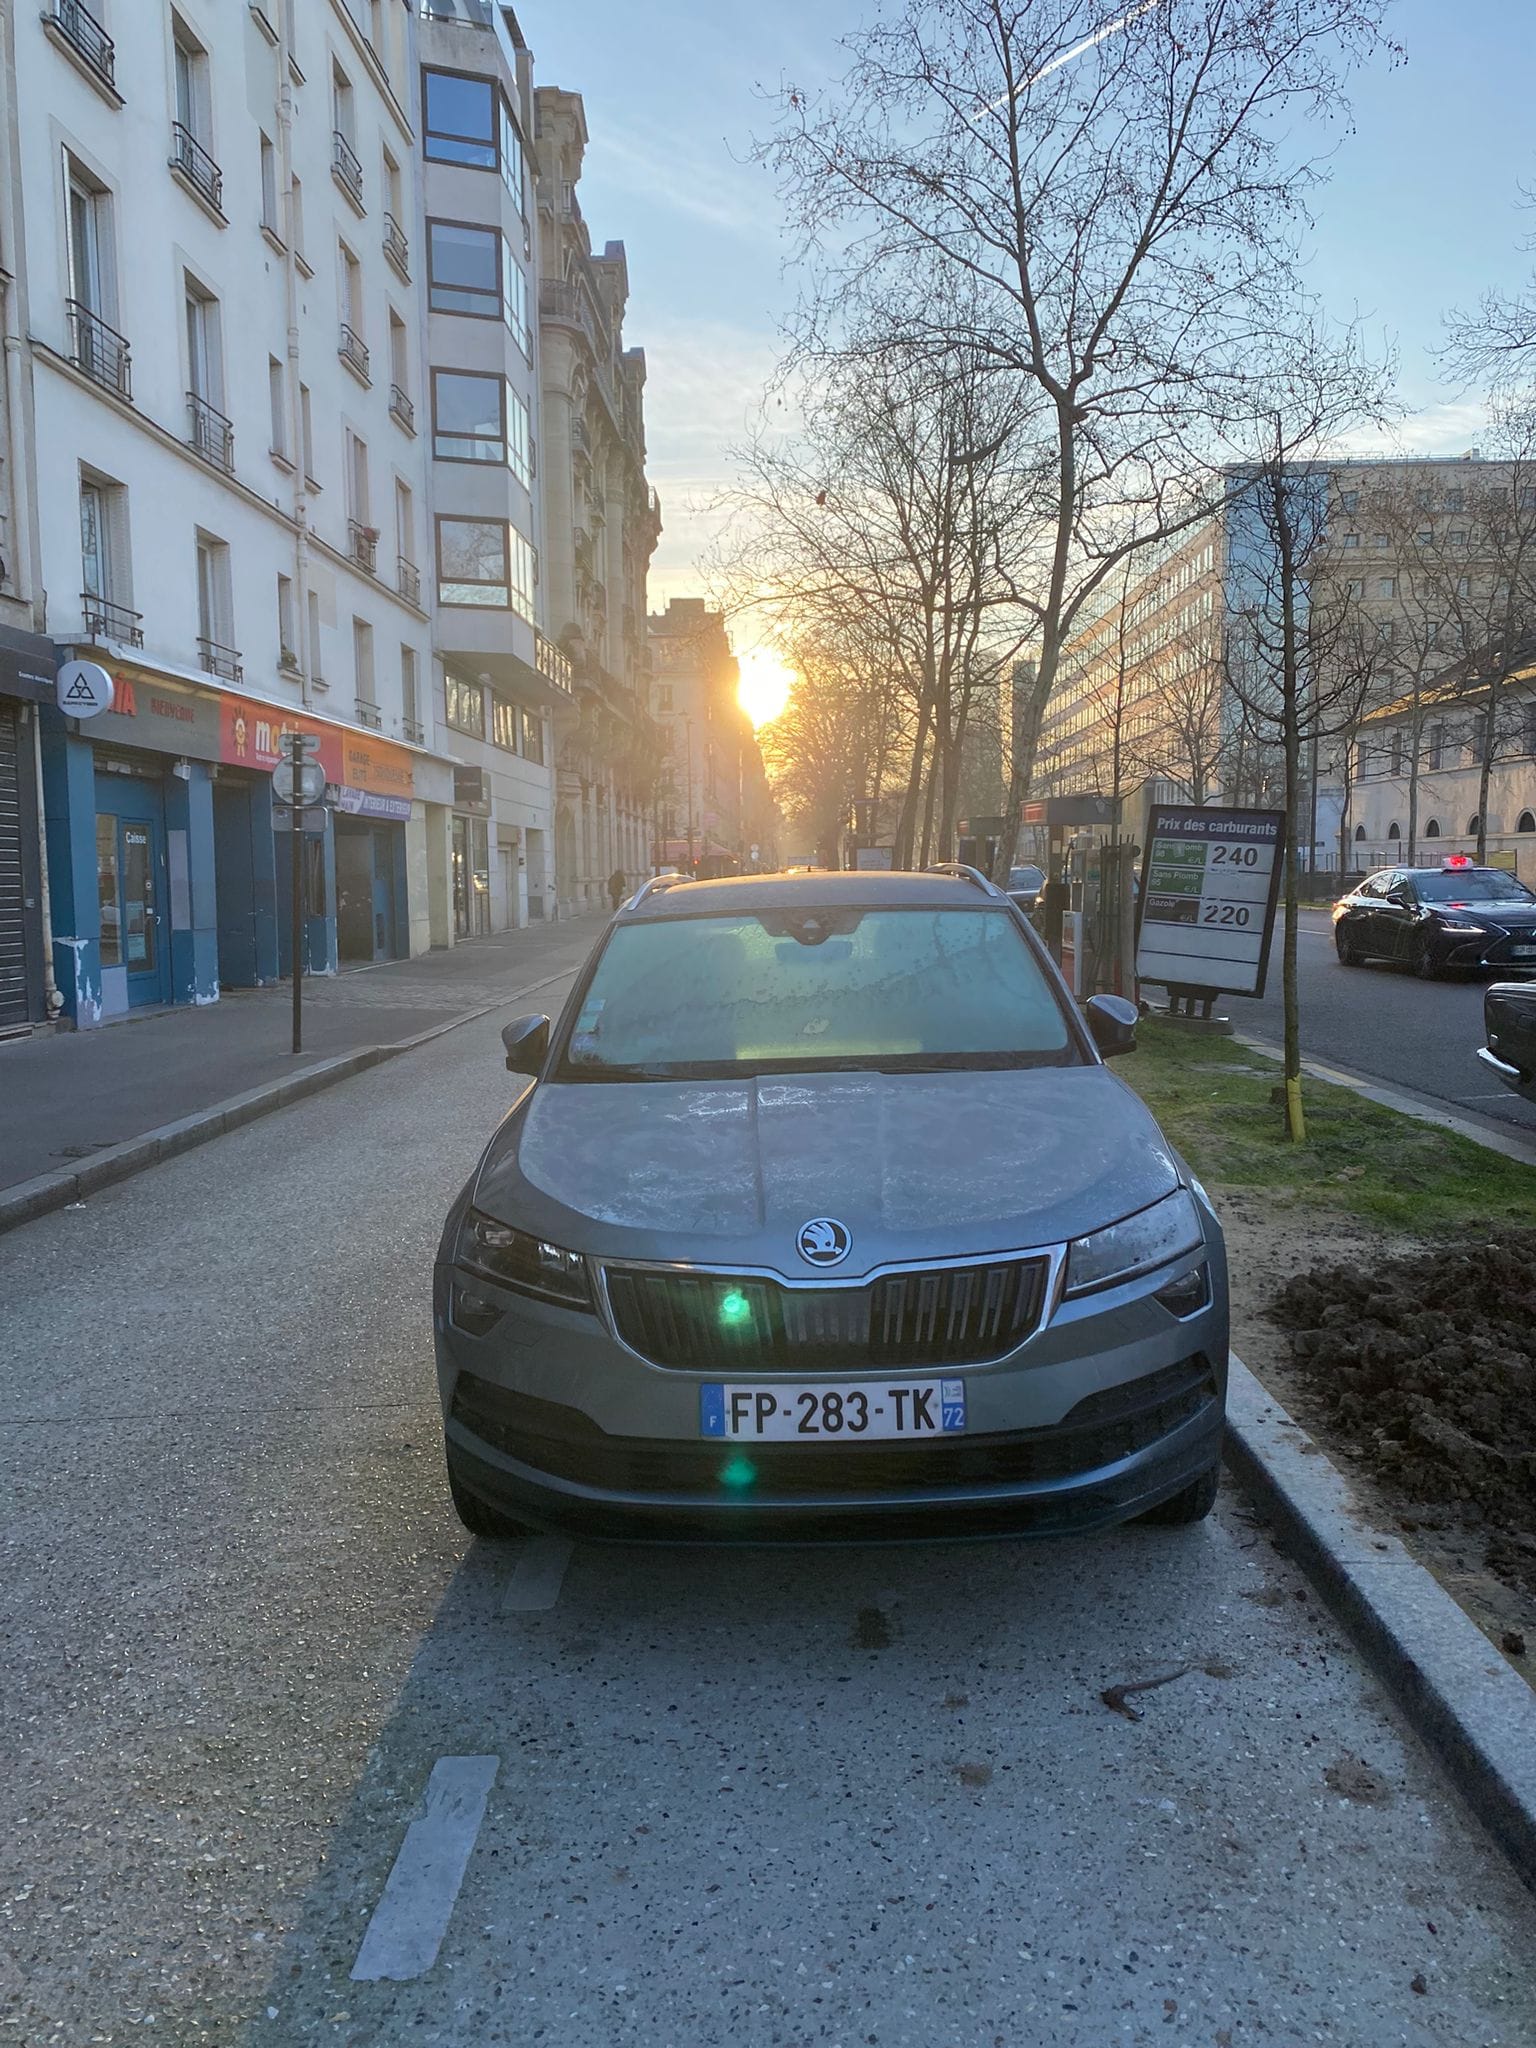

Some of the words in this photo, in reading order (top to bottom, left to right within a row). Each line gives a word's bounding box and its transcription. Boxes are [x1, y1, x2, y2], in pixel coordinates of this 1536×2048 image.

[1157, 817, 1180, 831] Prix
[1184, 819, 1206, 832] des
[1208, 821, 1278, 836] carburants
[125, 831, 147, 844] Caisse
[1212, 845, 1258, 867] 240
[1152, 870, 1171, 878] Sans
[1173, 871, 1199, 880] Plomb
[1204, 904, 1250, 926] 220
[731, 1388, 936, 1434] FP-283-TK
[943, 1407, 965, 1427] 72
[709, 1415, 717, 1428] F
